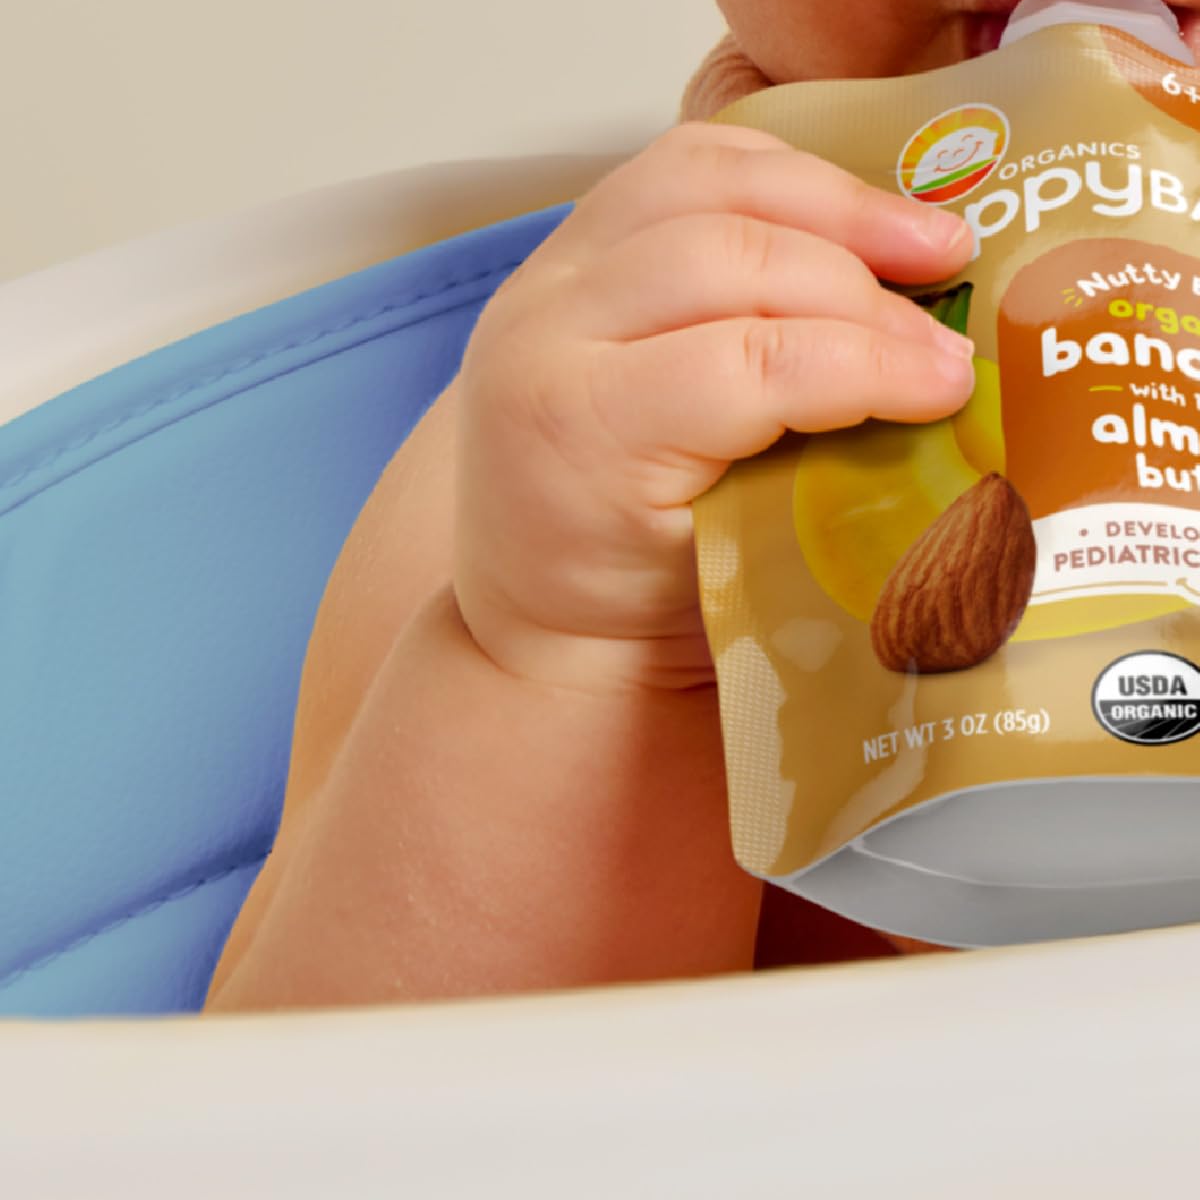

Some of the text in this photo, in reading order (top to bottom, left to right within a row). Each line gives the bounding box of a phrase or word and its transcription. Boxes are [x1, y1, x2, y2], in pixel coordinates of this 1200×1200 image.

[999, 141, 1142, 181] ORGANICS
[1076, 263, 1181, 298] Nutty
[1129, 381, 1187, 408] with
[1117, 674, 1189, 698] USDA
[1110, 703, 1199, 721] ORGANIC
[863, 707, 1052, 765] NET WT 3 OZ (85g)
